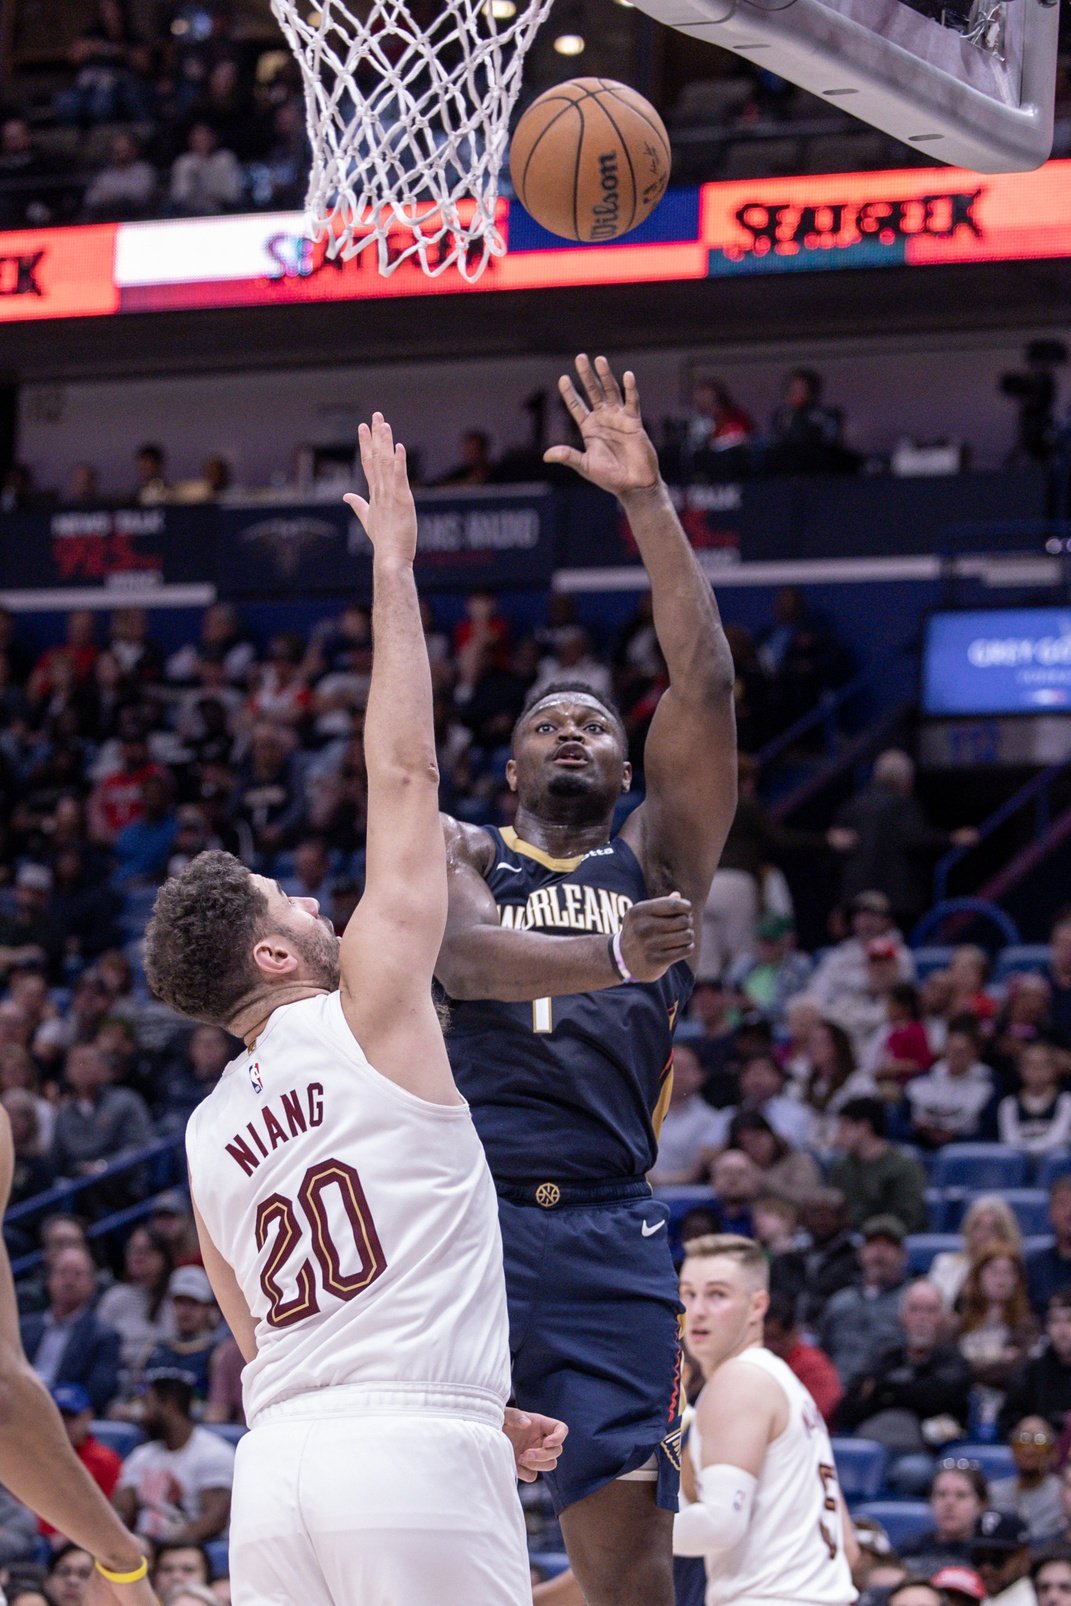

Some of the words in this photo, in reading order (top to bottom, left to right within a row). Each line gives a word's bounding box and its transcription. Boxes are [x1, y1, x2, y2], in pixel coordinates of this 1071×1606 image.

[590, 149, 618, 239] Wilson
[224, 1082, 324, 1178] NIANG
[255, 1157, 388, 1328] 20
